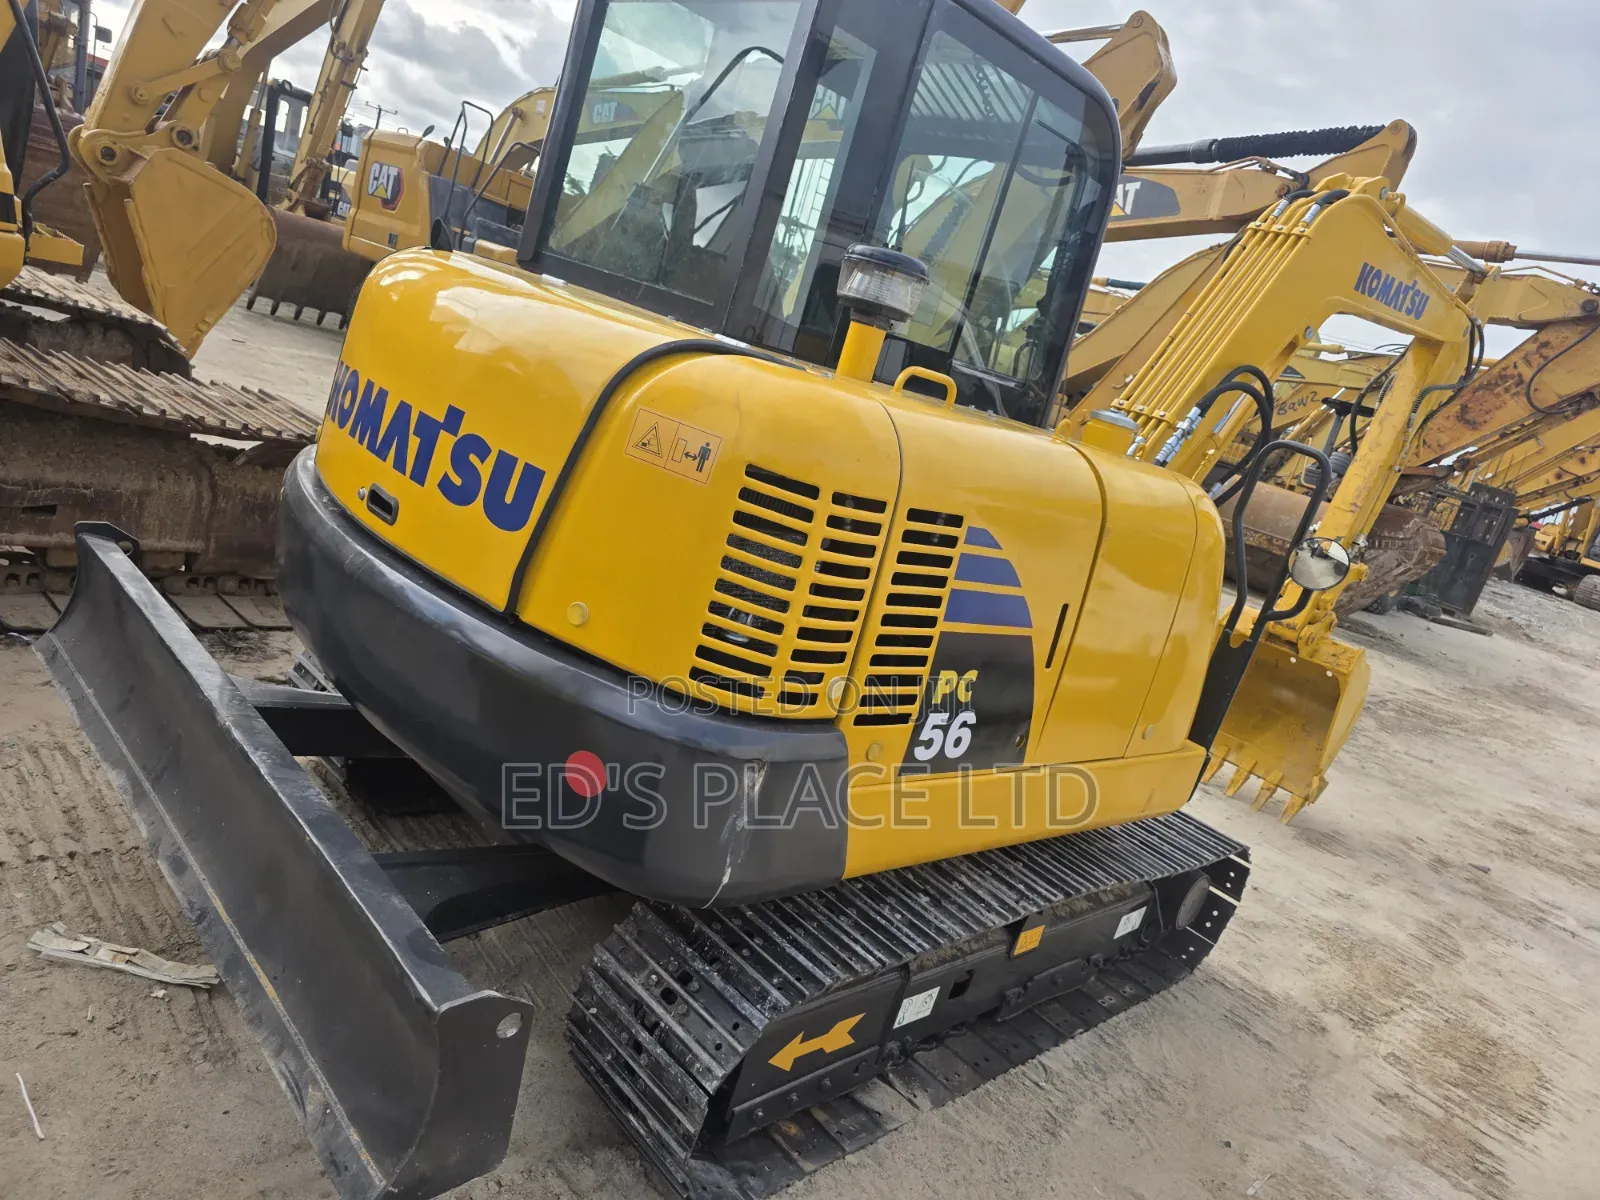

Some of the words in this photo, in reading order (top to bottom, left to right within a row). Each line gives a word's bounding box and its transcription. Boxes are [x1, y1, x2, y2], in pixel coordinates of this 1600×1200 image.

[592, 102, 618, 124] CAT
[367, 162, 399, 200] CAT
[1113, 181, 1142, 215] AT
[337, 201, 351, 218] CAT
[1353, 261, 1430, 321] KOMATSU
[326, 360, 547, 532] KOMATSU
[931, 669, 979, 704] PC
[913, 710, 977, 761] 56
